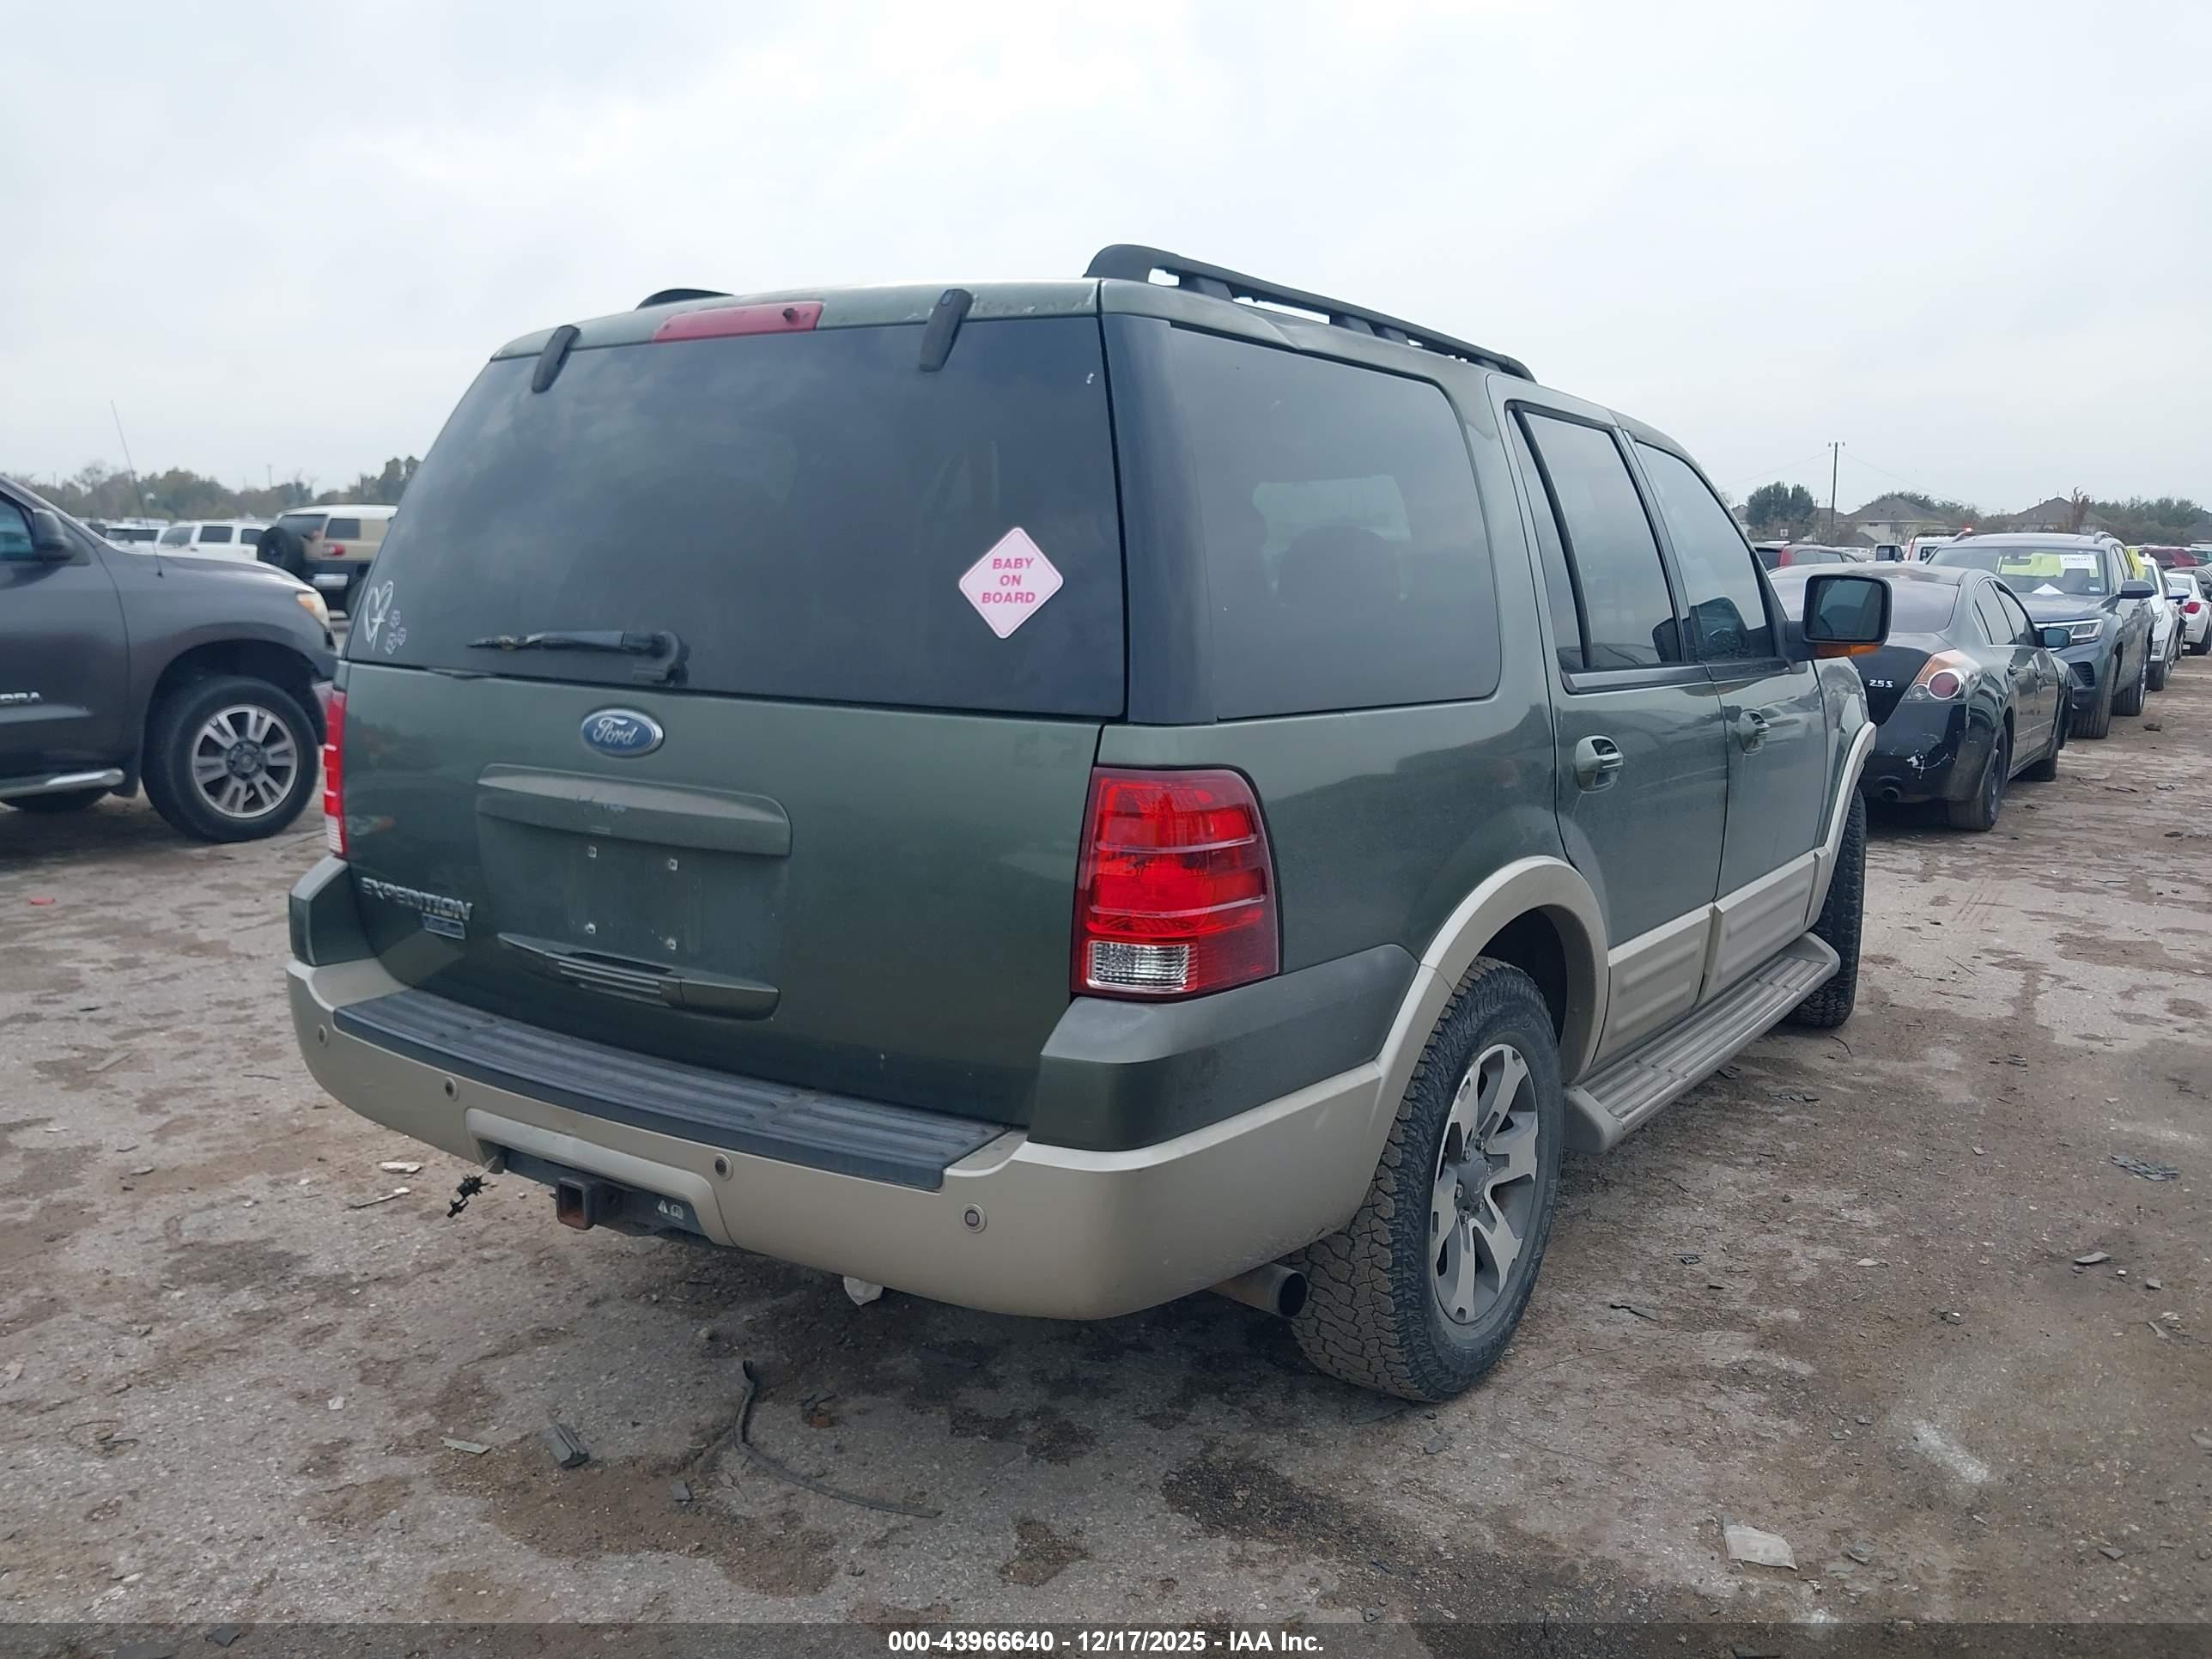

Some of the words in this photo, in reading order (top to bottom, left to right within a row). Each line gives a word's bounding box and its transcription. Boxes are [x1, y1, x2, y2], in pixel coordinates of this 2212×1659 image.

[992, 557, 1035, 569] BABY
[1000, 574, 1022, 586] ON
[981, 592, 1036, 604] BOARD
[592, 716, 639, 745] Ford
[361, 877, 473, 921] EXPEDITION
